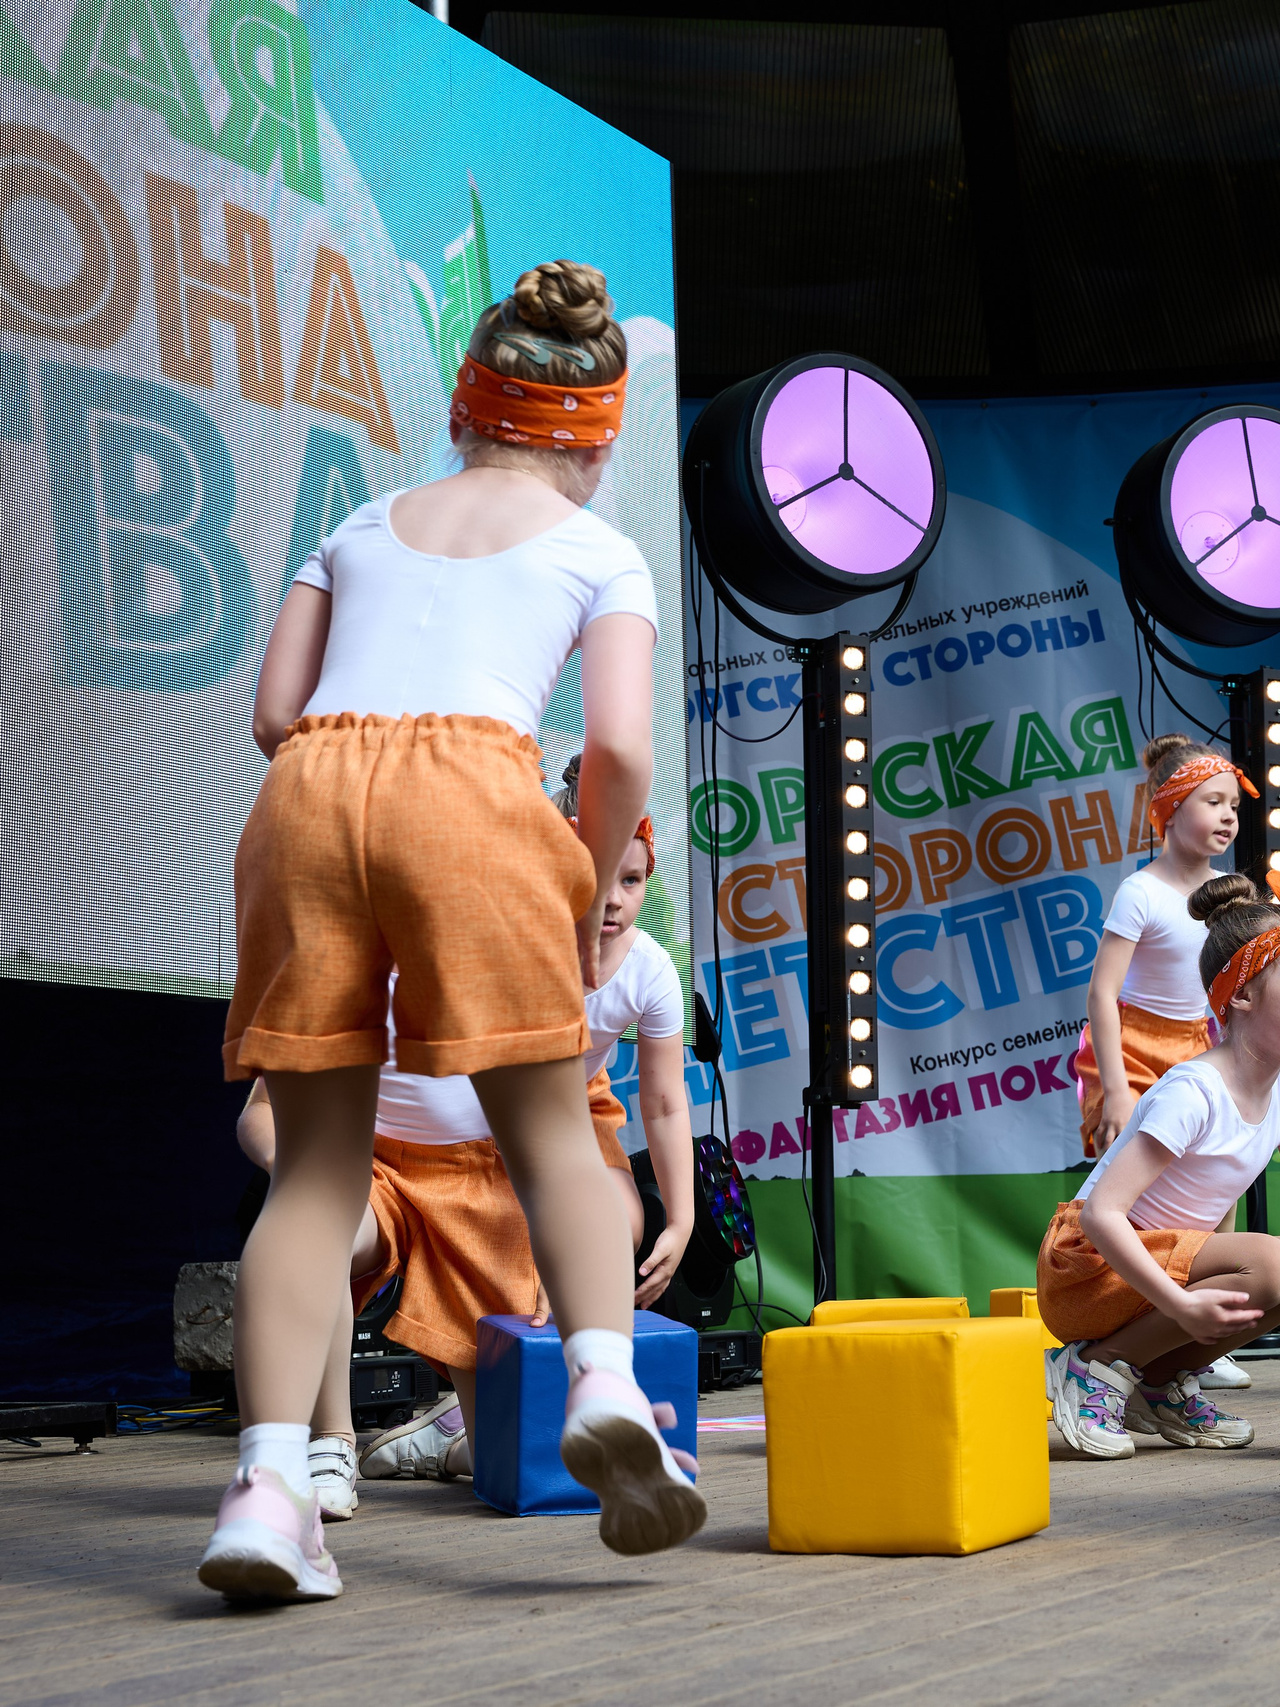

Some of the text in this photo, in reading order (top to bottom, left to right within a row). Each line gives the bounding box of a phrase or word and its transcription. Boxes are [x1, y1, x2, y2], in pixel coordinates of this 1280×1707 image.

[687, 648, 767, 679] ольных
[961, 579, 1089, 623] учреждений
[882, 608, 1106, 687] СТОРОНЫ
[910, 1017, 1090, 1075] Конкурс семейно
